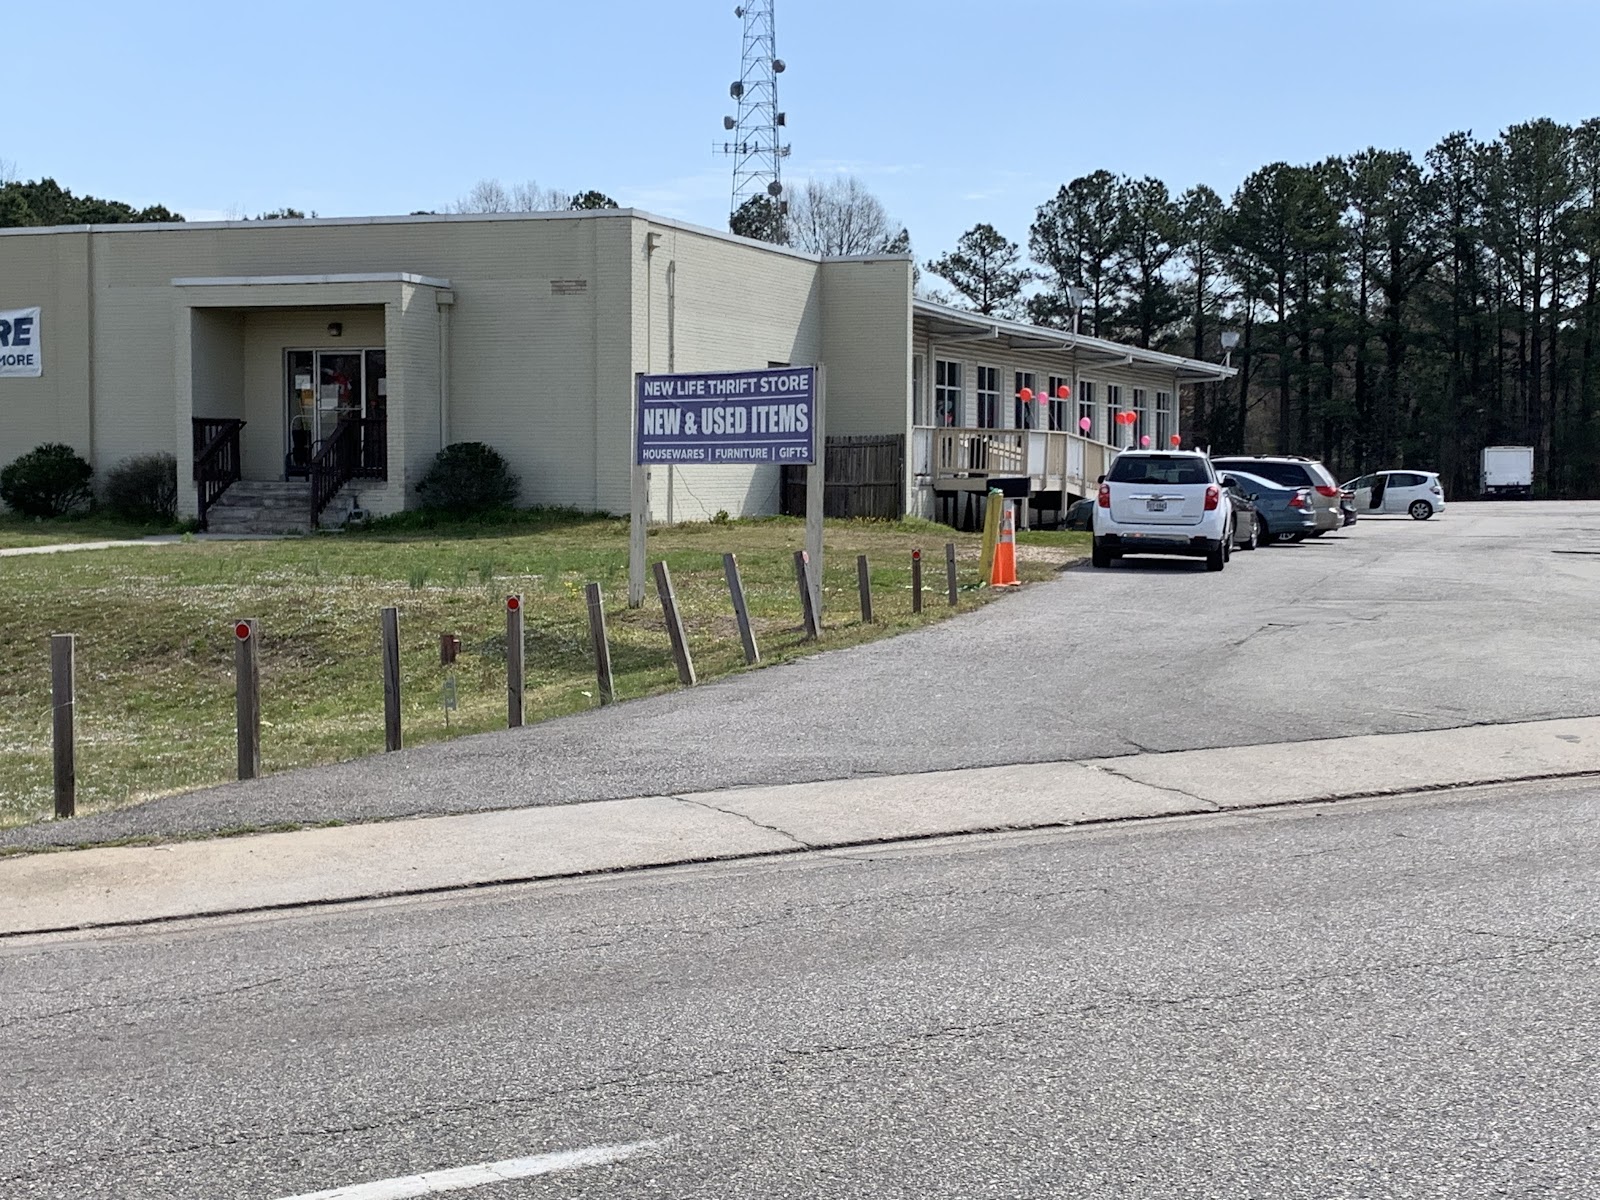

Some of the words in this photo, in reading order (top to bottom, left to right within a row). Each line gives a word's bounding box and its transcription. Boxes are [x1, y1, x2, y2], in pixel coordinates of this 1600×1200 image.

[644, 381, 674, 396] NEW
[677, 380, 705, 395] LIFE
[708, 378, 757, 394] THRIFT
[760, 374, 809, 392] STORE
[643, 408, 681, 435] NEW
[684, 412, 698, 435] &
[701, 406, 747, 434] USED
[751, 403, 809, 433] ITEMS
[643, 448, 705, 460] HOUSEWARES
[715, 447, 768, 459] FURNITURE
[779, 446, 808, 458] GIFTS
